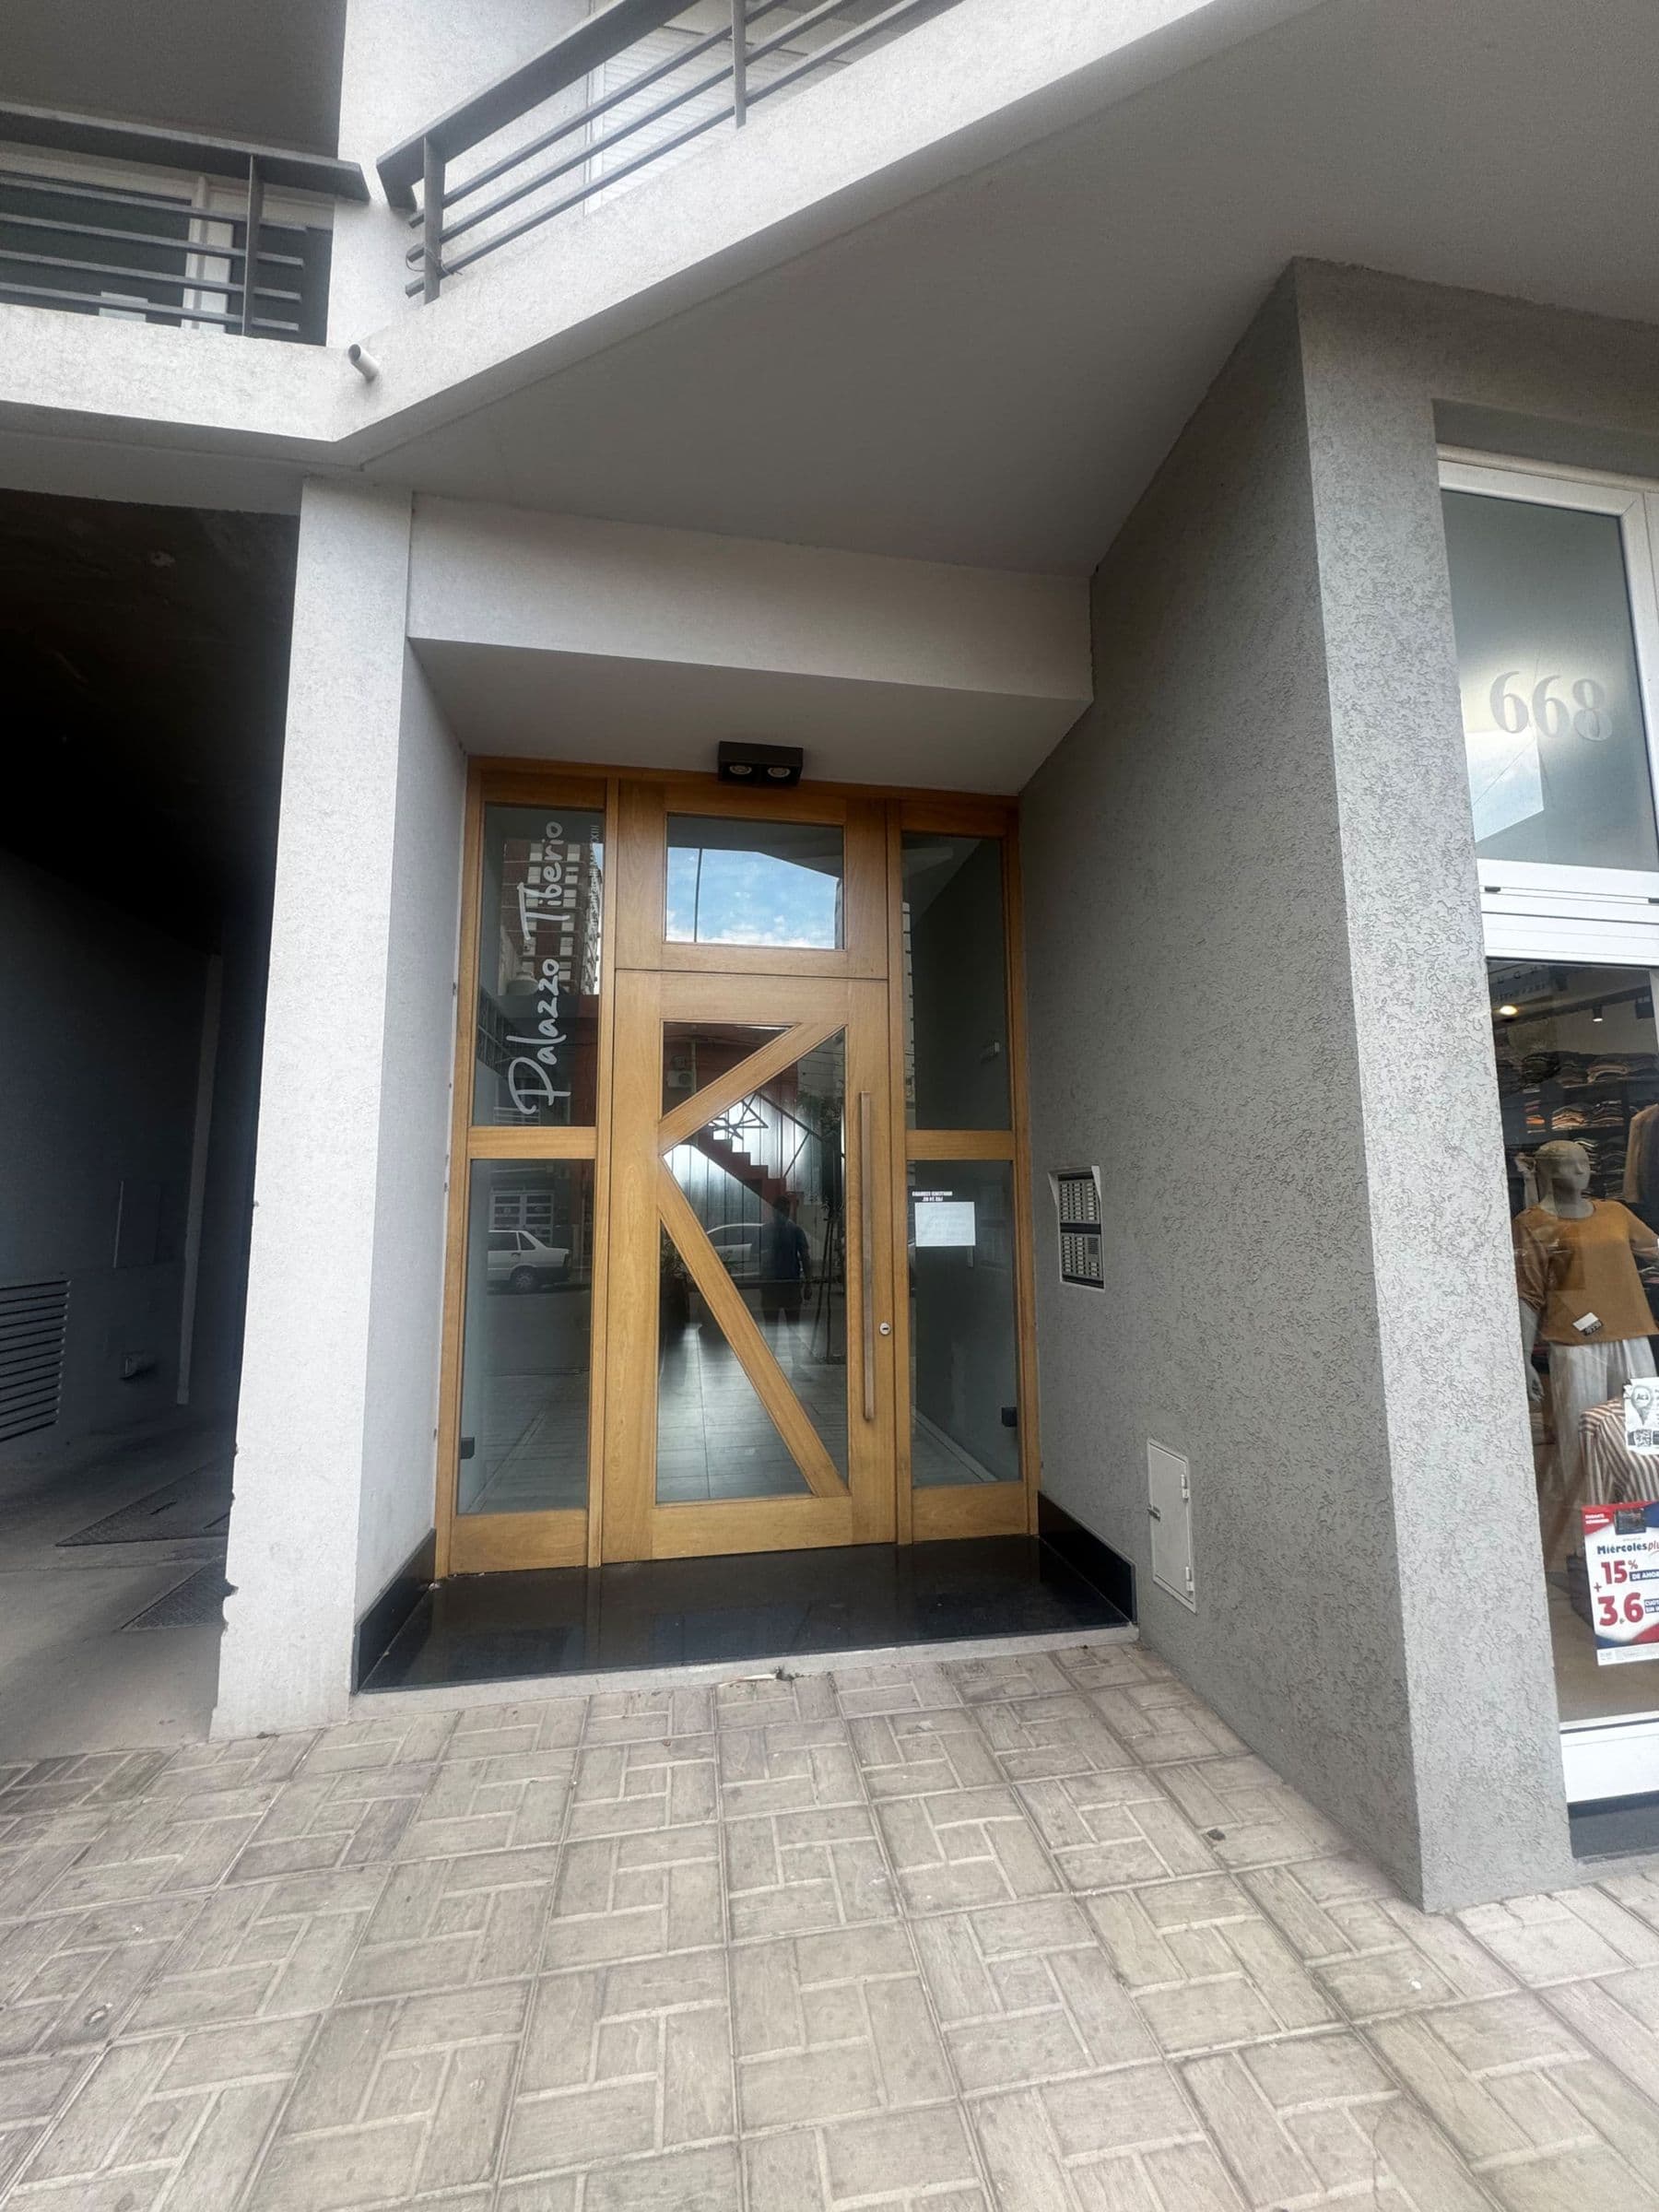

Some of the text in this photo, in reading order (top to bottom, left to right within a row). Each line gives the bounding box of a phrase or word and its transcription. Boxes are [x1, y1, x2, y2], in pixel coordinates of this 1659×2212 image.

[1489, 670, 1613, 742] 668
[505, 821, 571, 1115] Palazzo Tiberio
